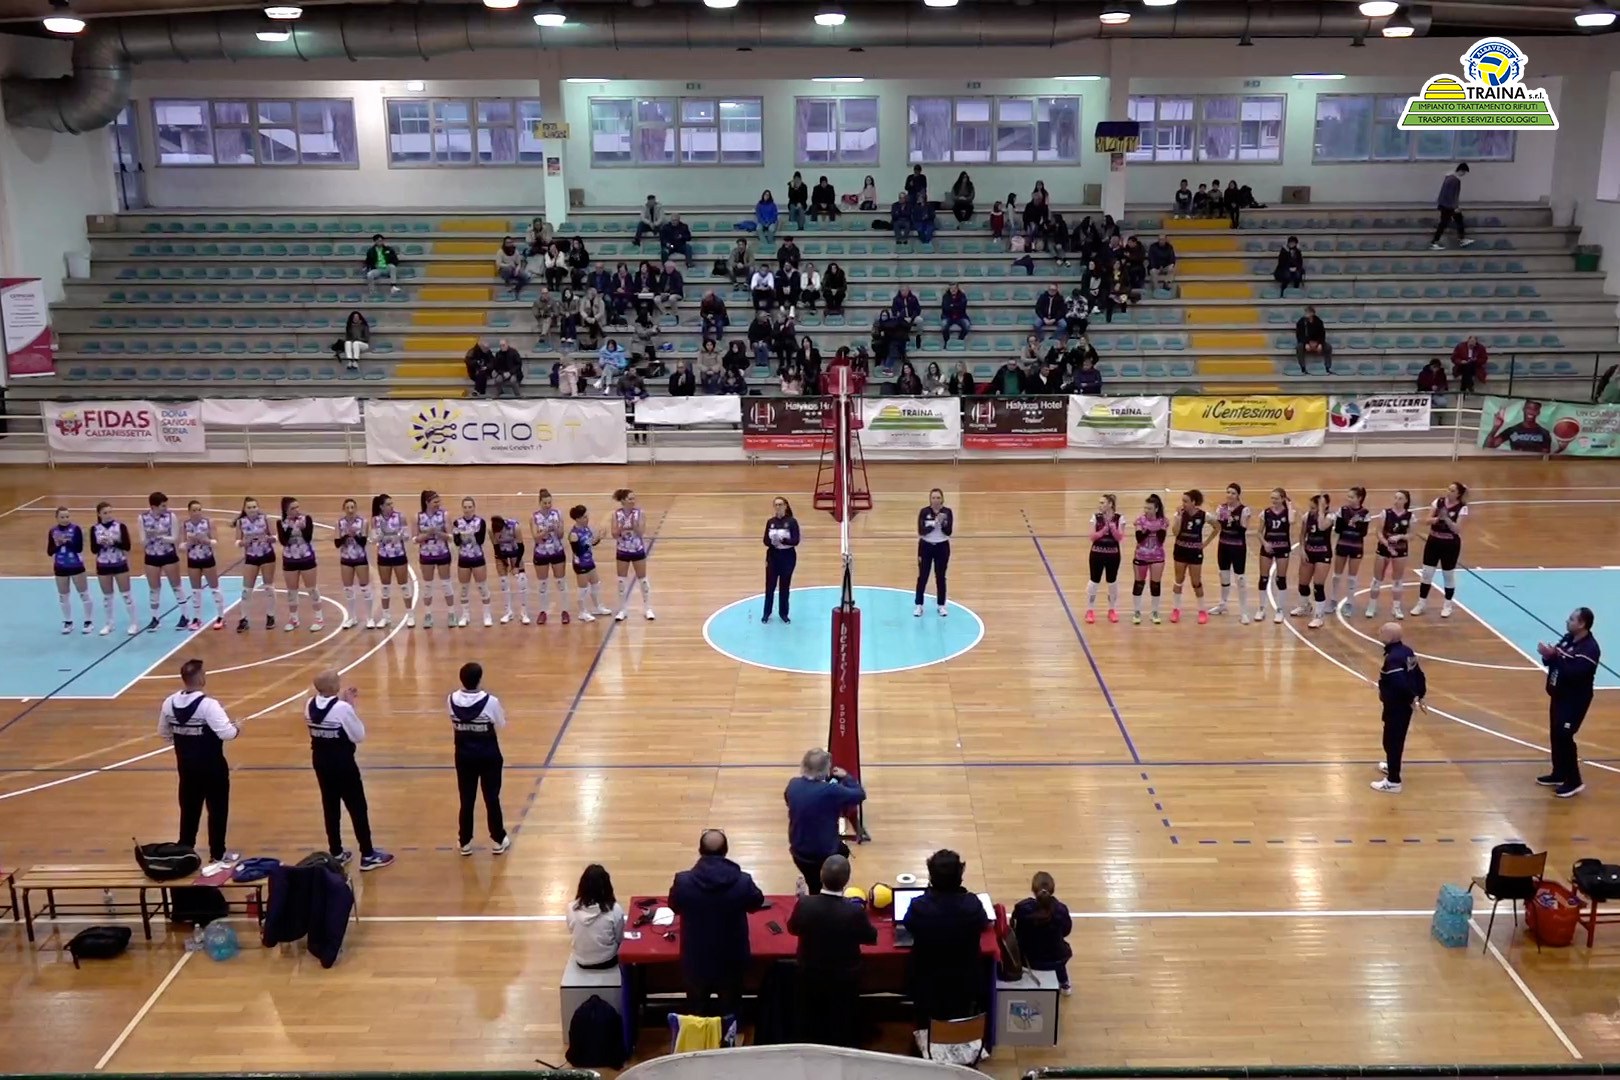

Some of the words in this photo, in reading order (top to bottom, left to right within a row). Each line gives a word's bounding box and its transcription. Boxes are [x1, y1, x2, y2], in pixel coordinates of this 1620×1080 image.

[1040, 400, 1063, 410] Hotel
[902, 409, 933, 417] TRAINA
[1110, 408, 1142, 416] TRAINA
[1202, 404, 1212, 419] il
[1212, 400, 1282, 419] Centesimo
[161, 410, 188, 418] DONA
[83, 410, 150, 429] FIDAS
[161, 418, 197, 426] SANGUE
[85, 429, 152, 438] CALTANISSETTA
[162, 427, 189, 435] DONA
[164, 435, 182, 443] VITA
[1271, 519, 1282, 529] 17
